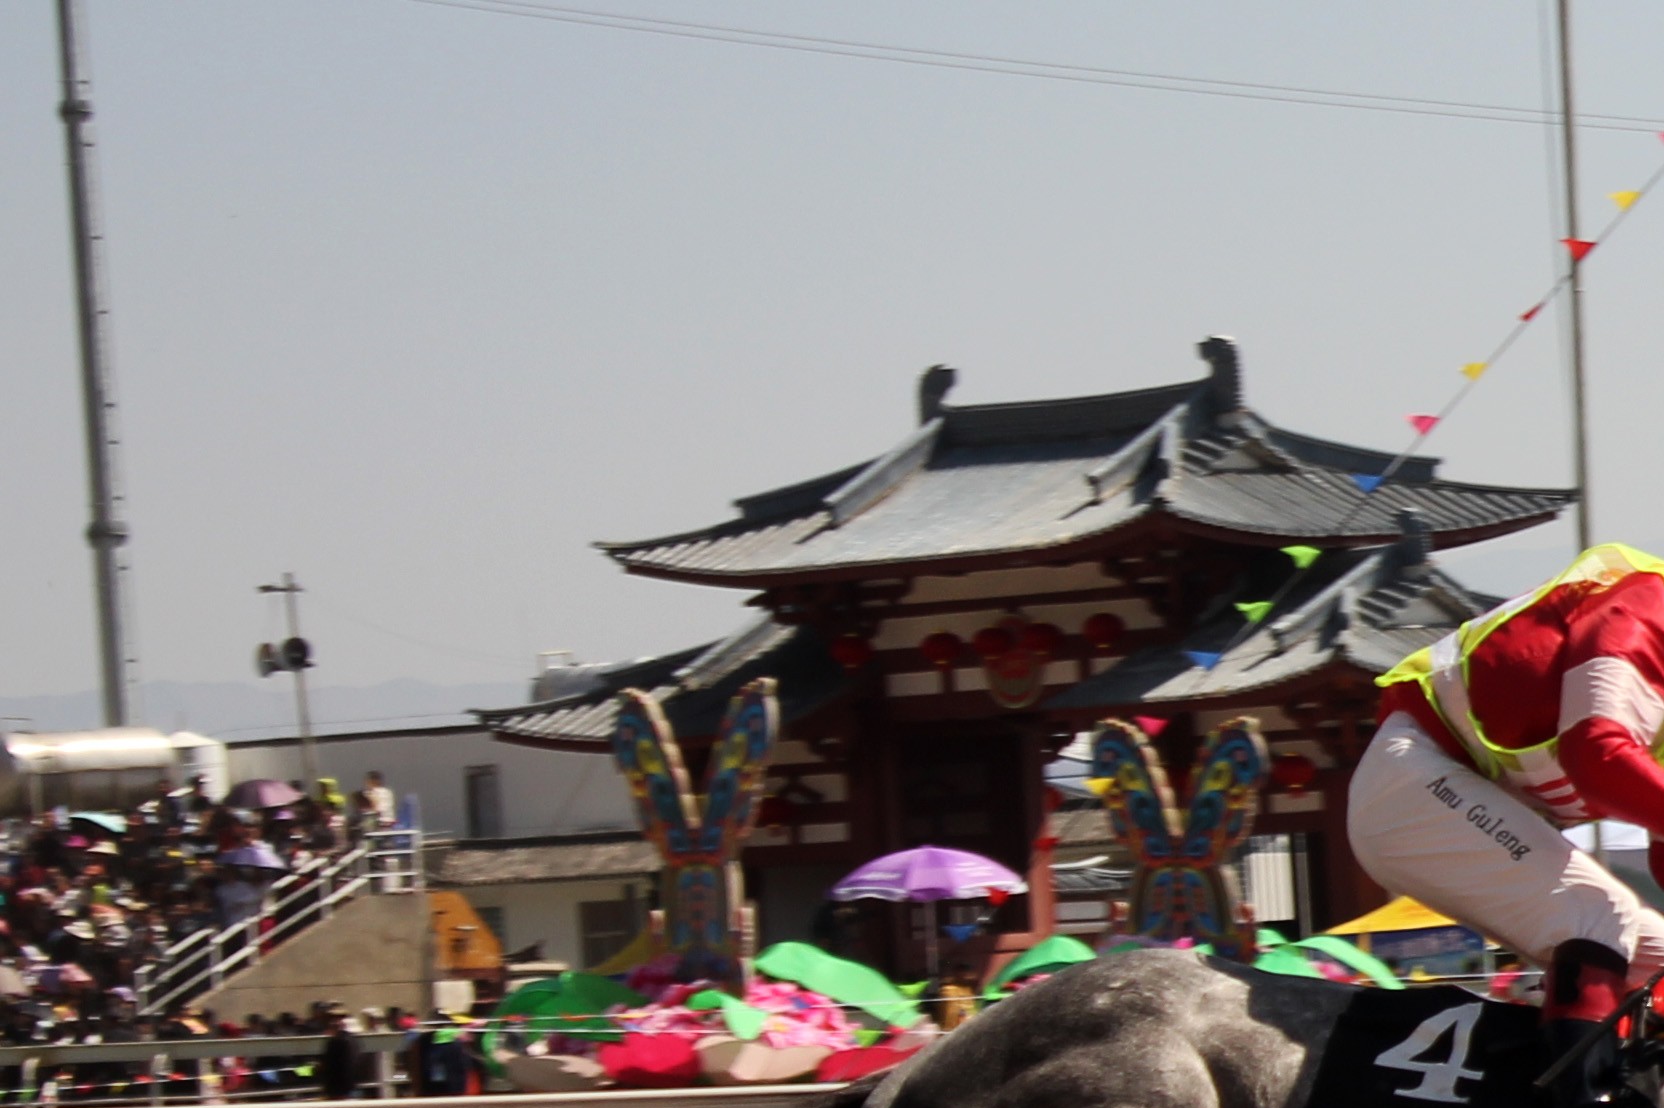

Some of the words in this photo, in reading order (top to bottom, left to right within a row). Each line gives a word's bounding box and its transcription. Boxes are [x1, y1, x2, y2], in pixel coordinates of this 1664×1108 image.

[1425, 776, 1463, 809] Amu
[1466, 804, 1531, 861] Guleng
[1374, 1002, 1485, 1104] 4
